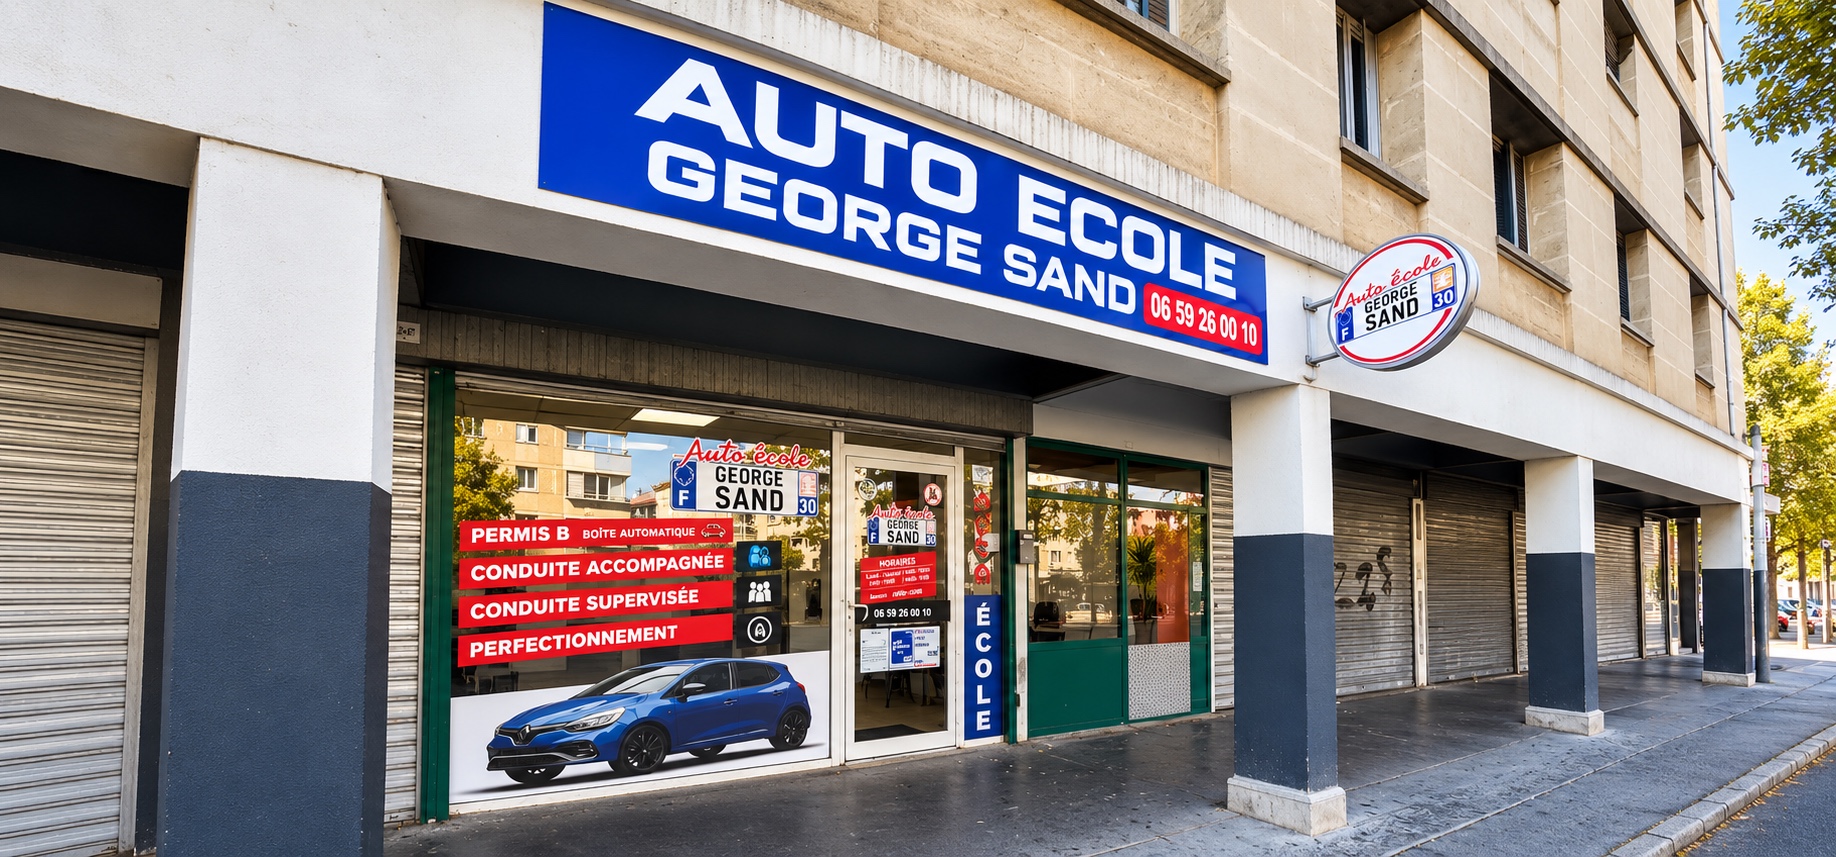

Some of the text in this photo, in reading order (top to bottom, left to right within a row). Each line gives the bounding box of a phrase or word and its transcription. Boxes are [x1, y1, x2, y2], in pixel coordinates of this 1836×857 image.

[634, 58, 1237, 300] AUTO ECOLE
[648, 140, 1136, 315] GEORGE SAND
[1336, 283, 1386, 314] Auto
[1364, 281, 1418, 313] GEORGE
[1434, 289, 1454, 308] 30
[1151, 292, 1257, 347] 06 59 26 00 10
[1365, 297, 1419, 331] SAND
[1341, 327, 1349, 341] F
[676, 438, 746, 467] Auto
[715, 466, 783, 487] GEORGE
[678, 490, 689, 506] F
[715, 486, 784, 511] SAND
[799, 498, 816, 514] 30
[471, 526, 570, 544] PERMIS B
[619, 527, 696, 539] AUTOMATIQUE
[870, 532, 877, 543] F
[887, 530, 919, 544] SAND
[926, 534, 936, 545] 30
[470, 552, 724, 582] CONDUITE ACCOMPAGNÉE
[879, 557, 916, 567] HORAIRES
[470, 586, 699, 620] CONDUITE SUPERVISÉE
[873, 608, 884, 618] 06
[898, 608, 908, 617] 26
[910, 608, 920, 617] 00
[922, 608, 931, 616] 10
[470, 625, 678, 658] PERFECTIONNEMENT
[974, 602, 993, 731] ÉCOLE
